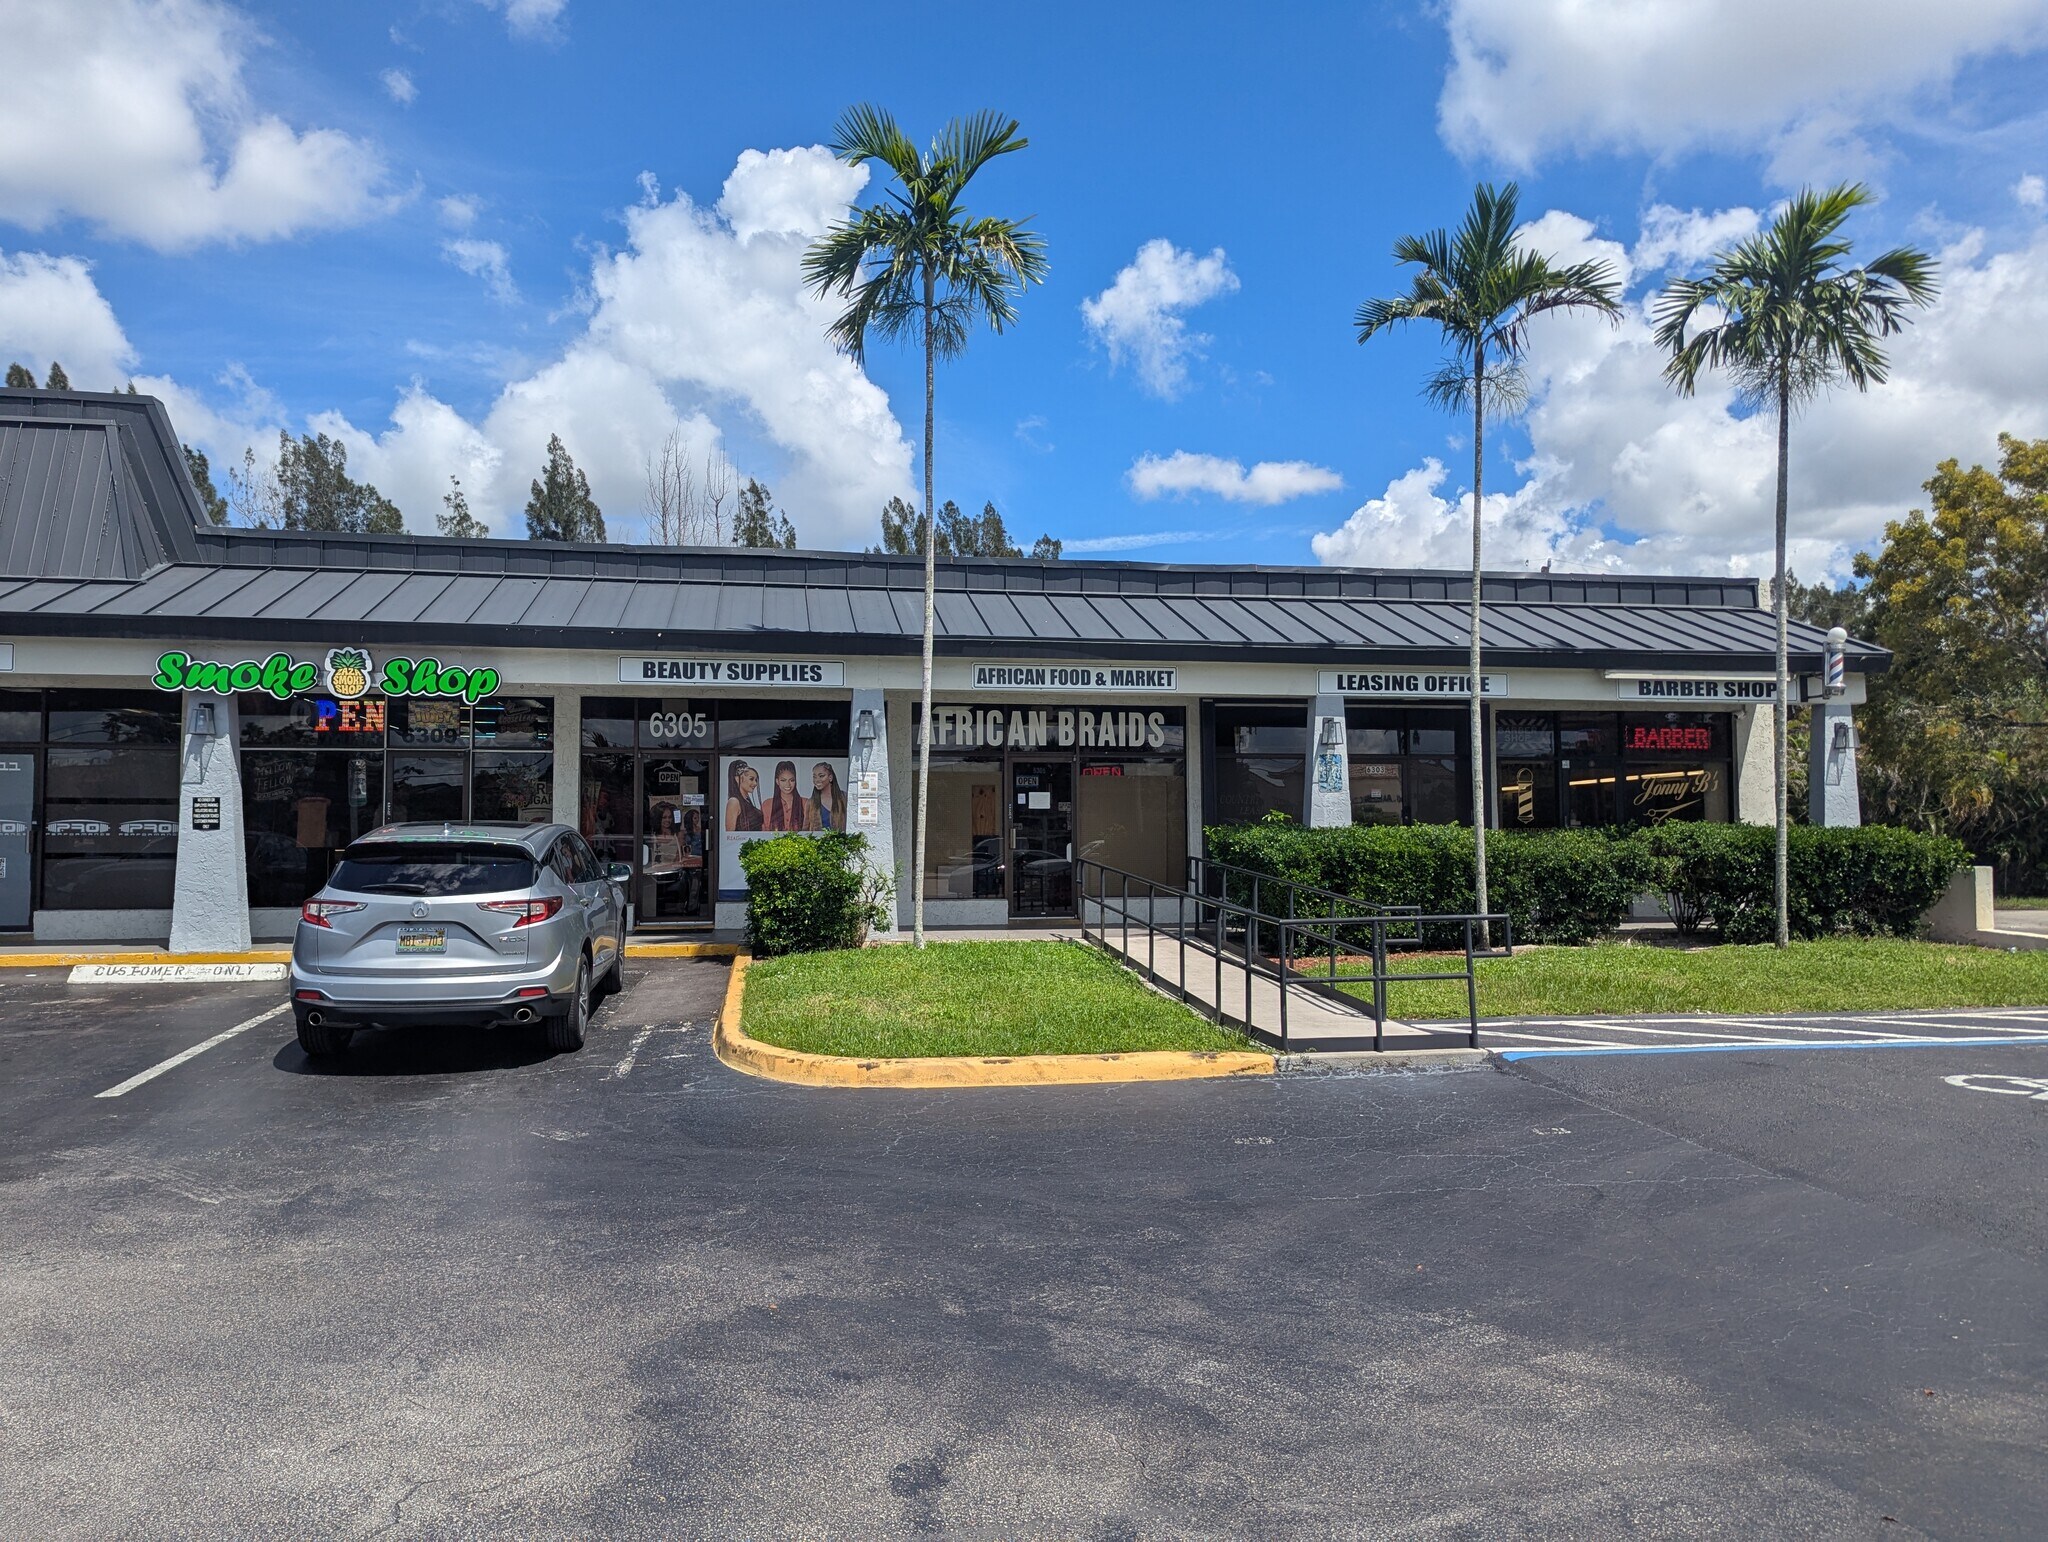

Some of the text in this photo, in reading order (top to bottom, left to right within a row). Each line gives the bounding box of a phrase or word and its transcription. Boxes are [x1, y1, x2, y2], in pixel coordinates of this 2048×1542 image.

[154, 653, 499, 702] Smoke Shop
[336, 667, 362, 676] ZAZA
[642, 661, 823, 683] BEAUTY SUPPLIES
[976, 667, 1174, 688] AFRICAN FOOD & MARKET
[333, 675, 365, 686] SMOKE
[1337, 674, 1419, 693] LEASING
[335, 684, 364, 695] SHOP
[1638, 680, 1777, 698] BARBER SHOP
[650, 712, 707, 738] 6305
[1058, 711, 1165, 749] BRAIDS
[402, 728, 458, 744] 6309
[1634, 727, 1709, 749] BARBER
[660, 773, 679, 782] OPEN
[1018, 777, 1037, 785] OPEN
[1633, 776, 1690, 806] Jonny
[56, 823, 100, 833] PRO
[129, 823, 172, 833] PRO
[429, 935, 444, 946] 703
[94, 965, 185, 977] CUSTOMER
[213, 966, 256, 977] ONLY
